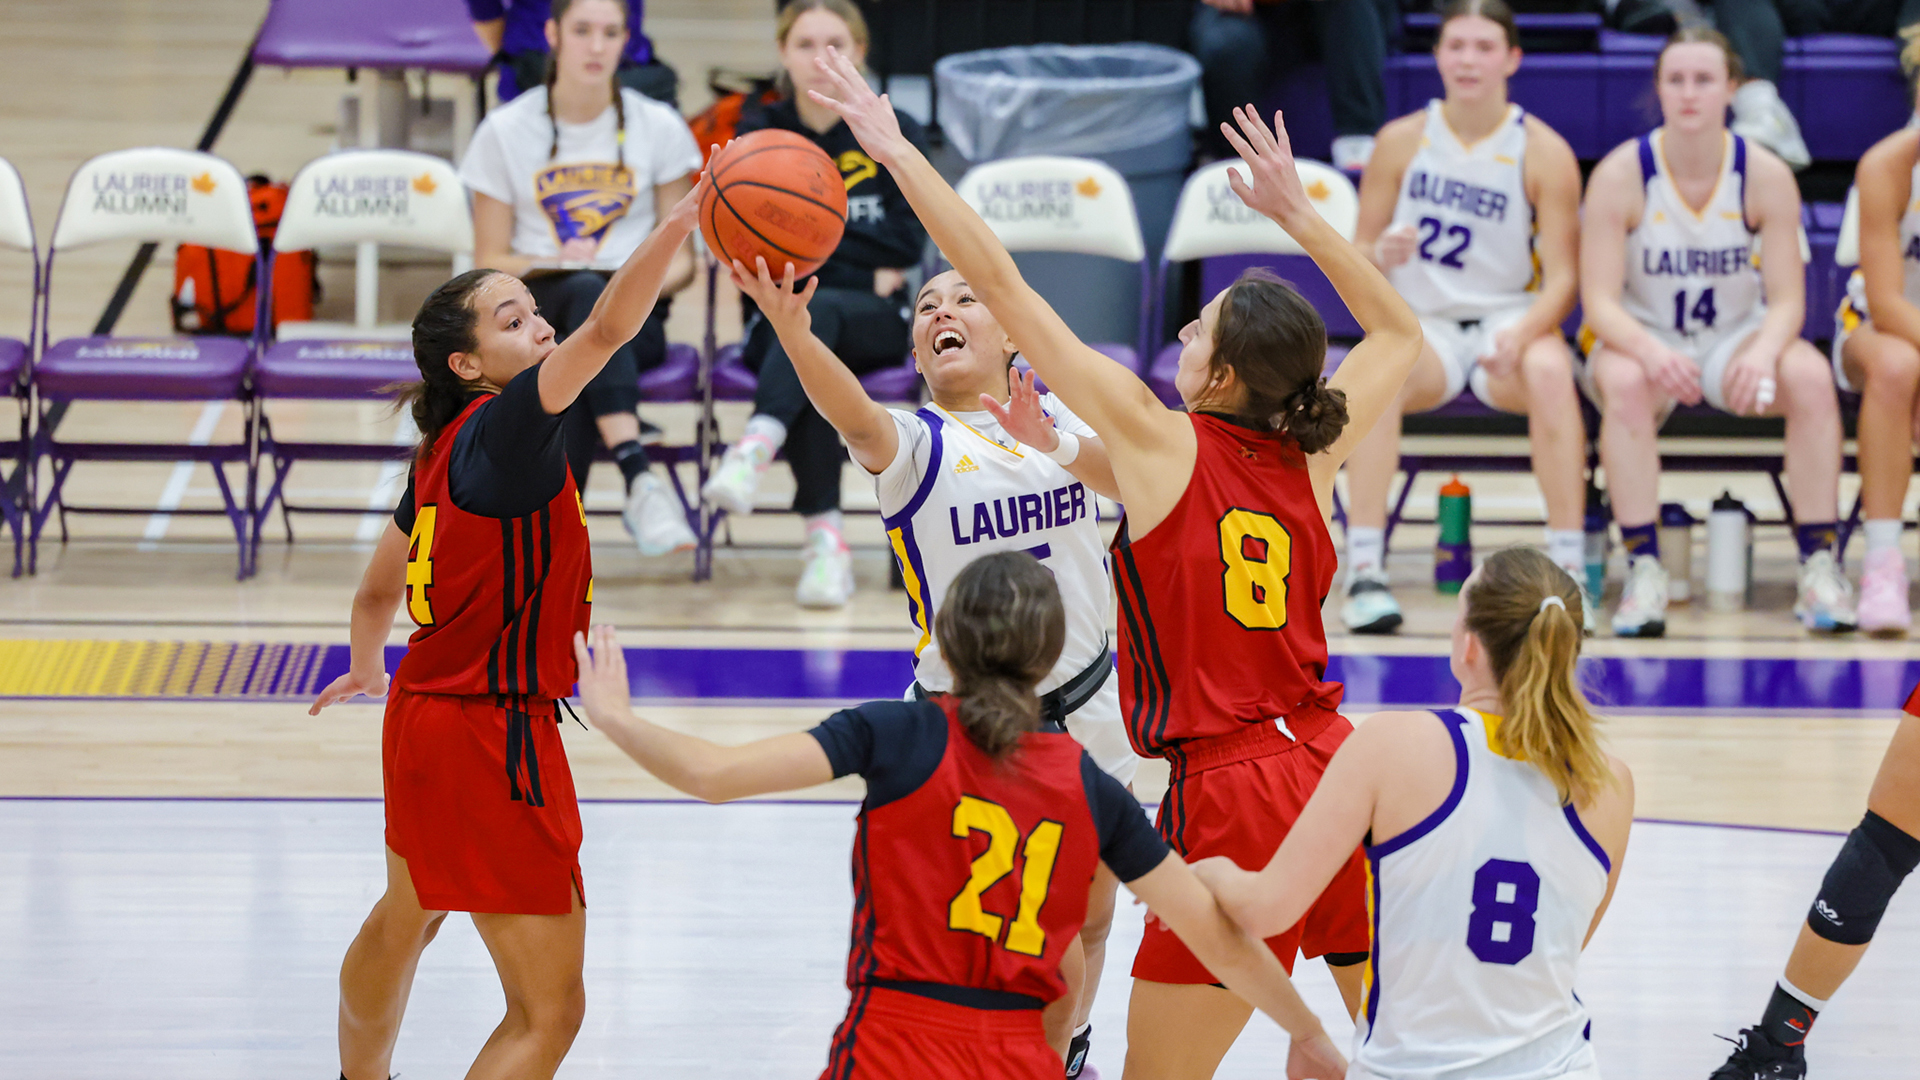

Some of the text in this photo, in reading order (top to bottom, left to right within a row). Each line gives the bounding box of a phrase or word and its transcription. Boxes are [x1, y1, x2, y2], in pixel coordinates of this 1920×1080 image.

[93, 173, 187, 194] LAURIER
[314, 176, 408, 198] LAURIER
[978, 181, 1072, 202] LAURIER
[94, 192, 187, 214] ALUMNI
[315, 197, 408, 217] ALUMNI
[981, 202, 1072, 222] ALUMNI
[1419, 216, 1472, 269] 22
[1643, 246, 1748, 276] LAURIER
[1675, 287, 1717, 332] 14
[953, 465, 980, 474] adidas
[950, 481, 1086, 545] LAURIER
[1216, 506, 1292, 632] 8
[948, 793, 1065, 958] 21
[1466, 858, 1541, 966] 8
